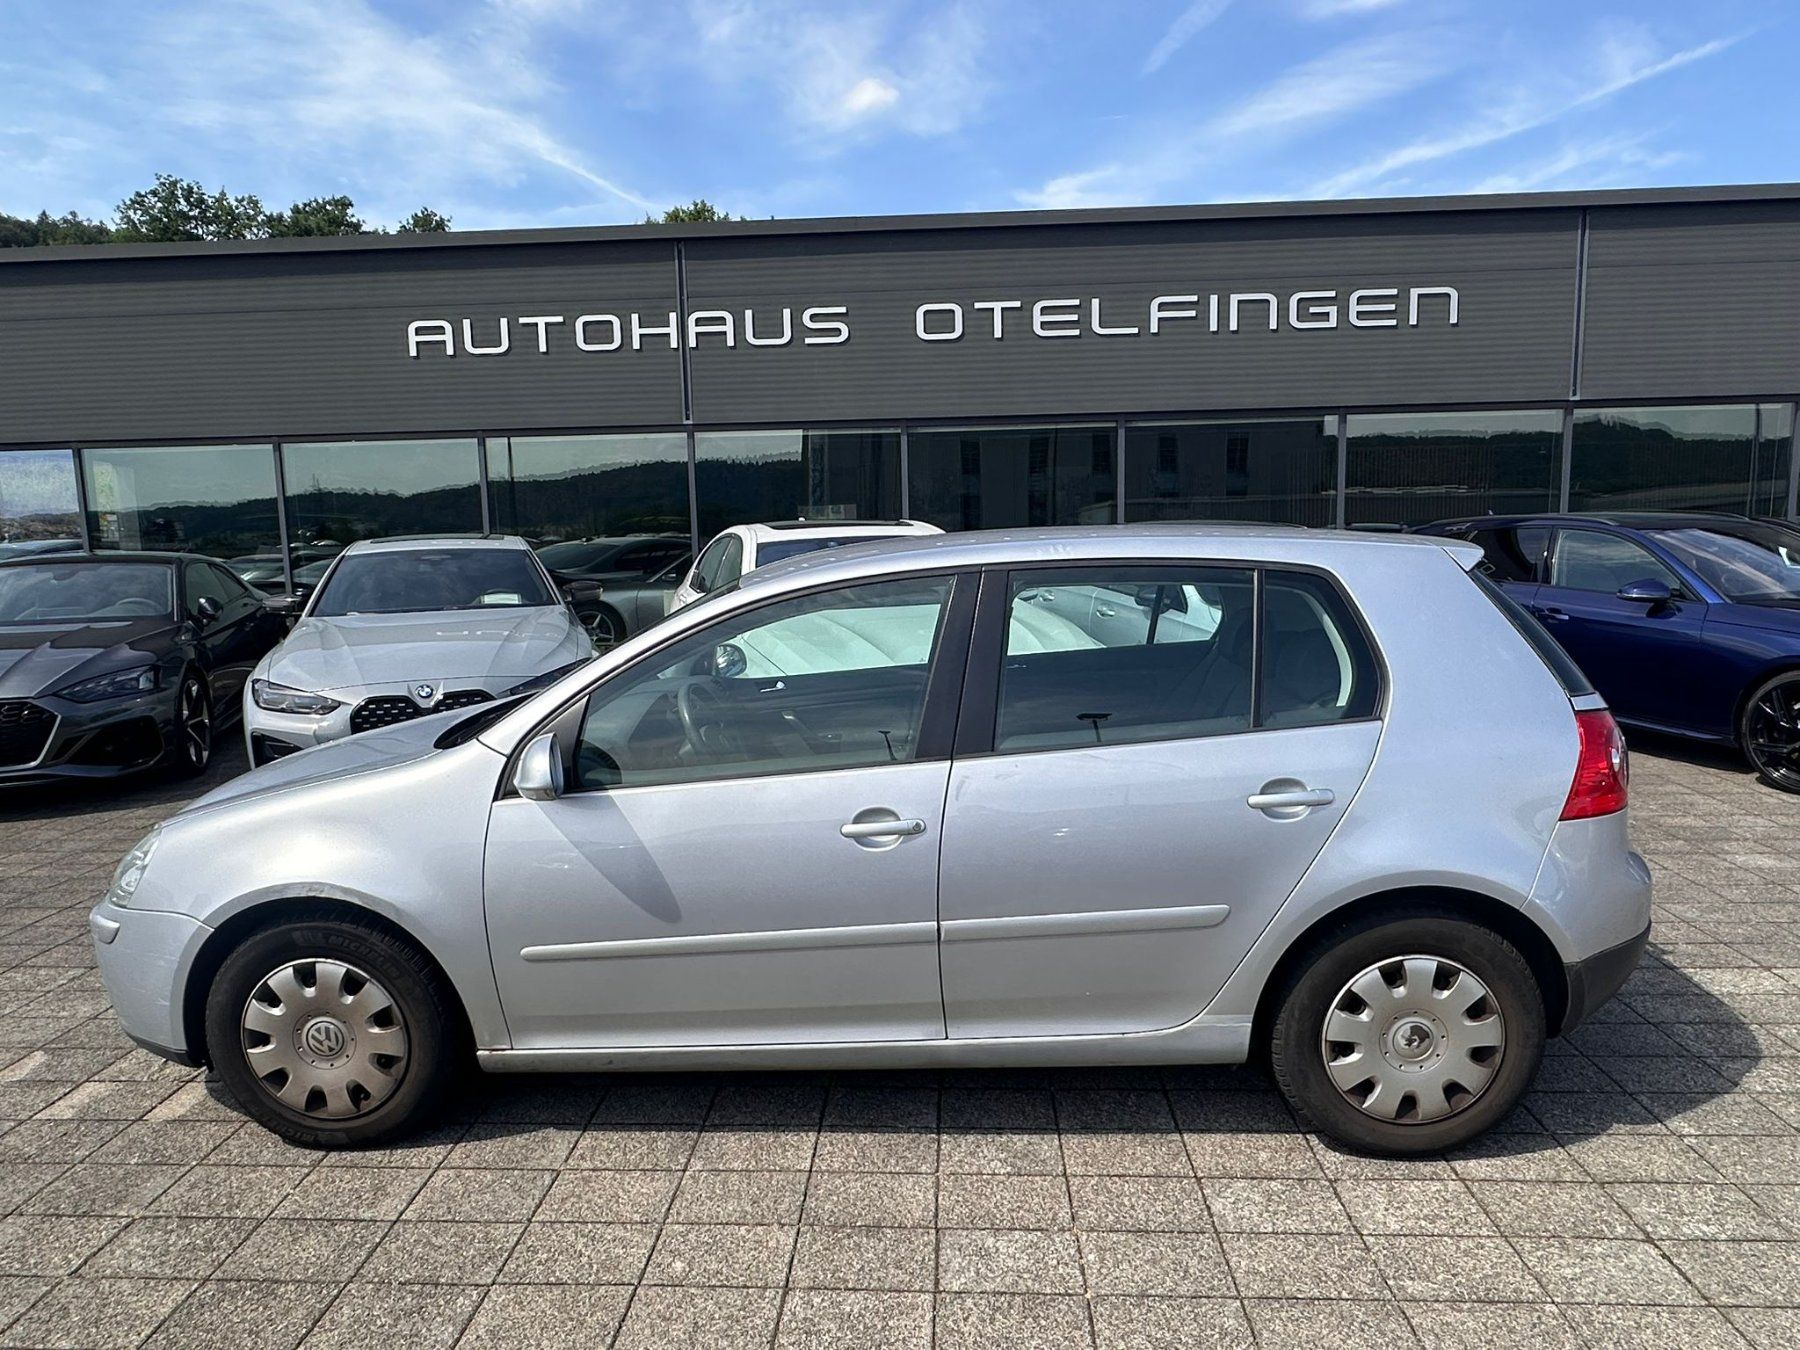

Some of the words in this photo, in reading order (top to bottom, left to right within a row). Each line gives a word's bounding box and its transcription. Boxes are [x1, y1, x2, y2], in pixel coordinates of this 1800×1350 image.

[407, 306, 850, 358] AUTOHAUS
[914, 286, 1460, 342] OTELFINGEN
[308, 1023, 343, 1055] VW
